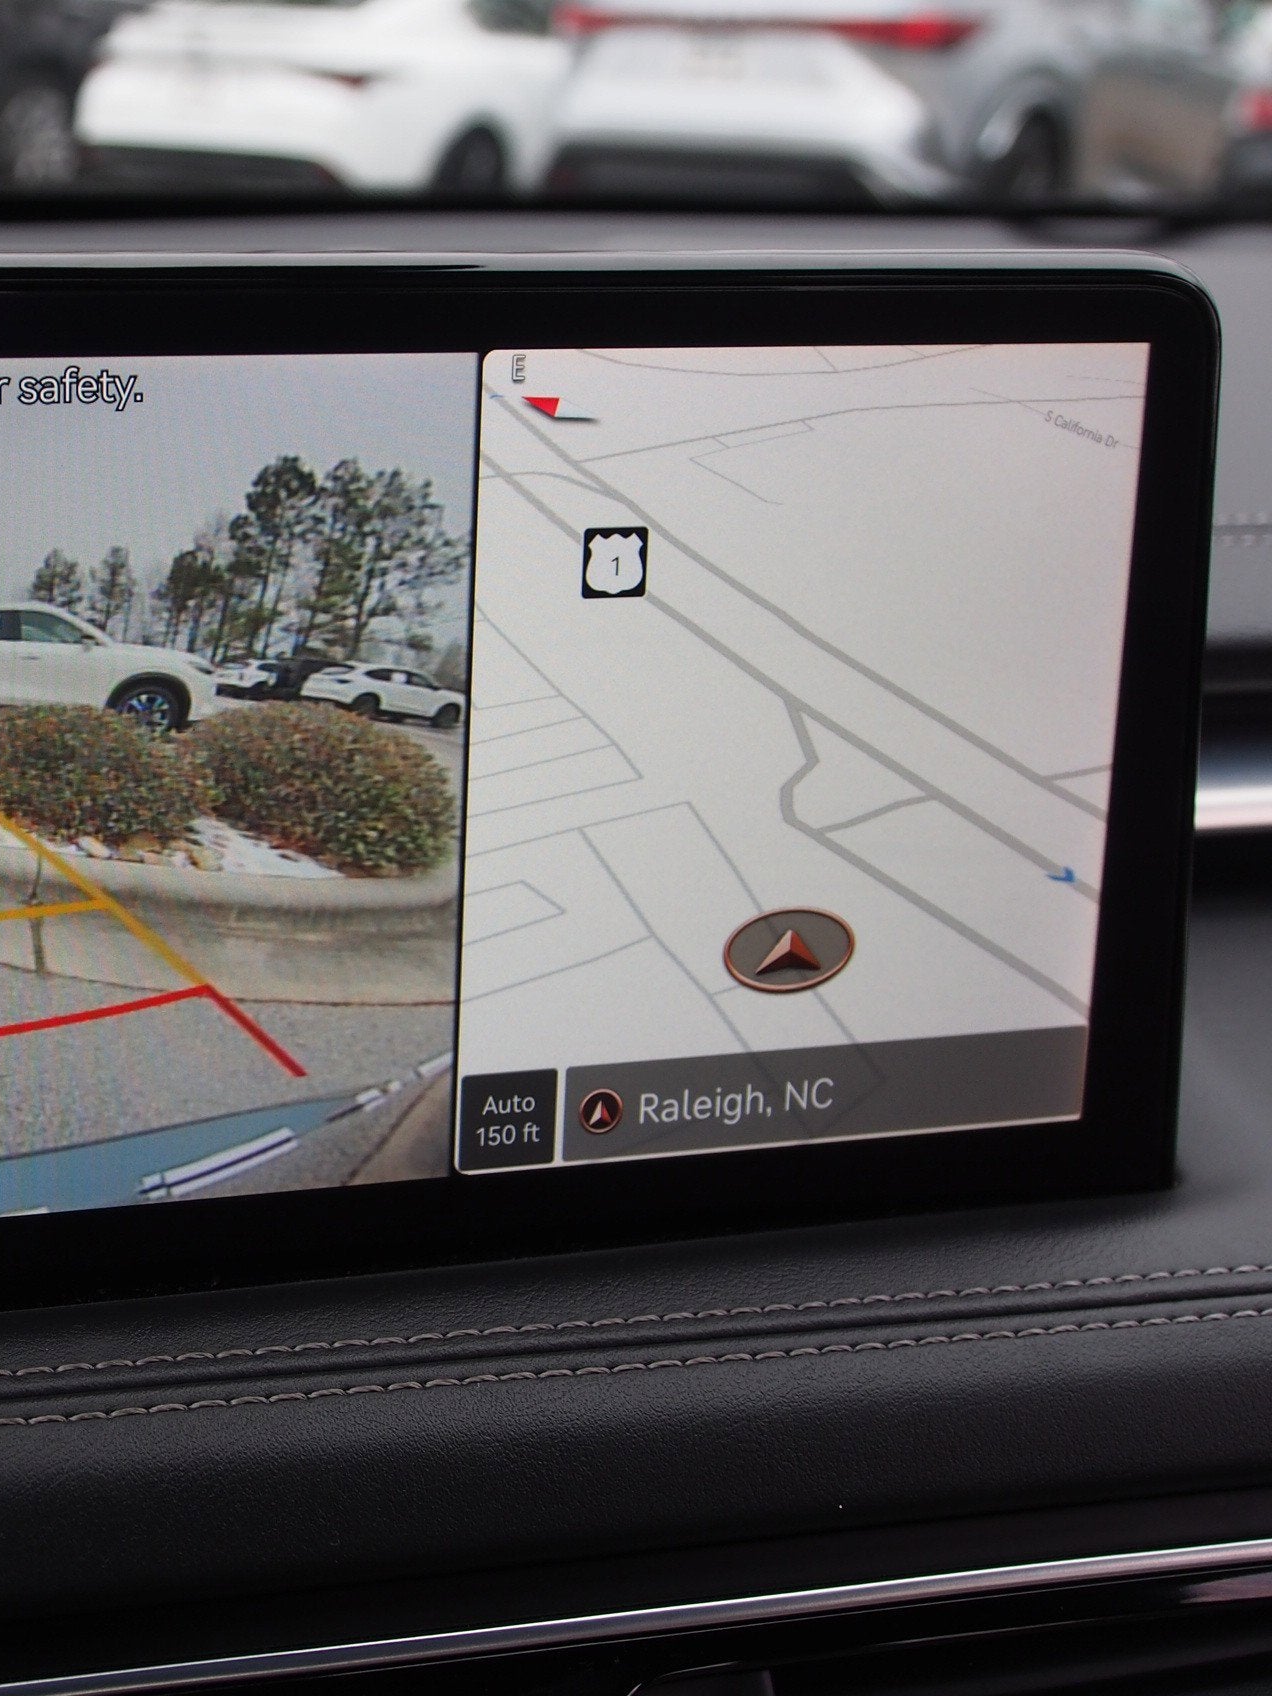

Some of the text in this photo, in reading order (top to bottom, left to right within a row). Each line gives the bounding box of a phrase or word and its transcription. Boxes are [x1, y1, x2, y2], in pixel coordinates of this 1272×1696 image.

[512, 354, 526, 383] E
[18, 366, 144, 412] safety.
[1044, 410, 1119, 448] S California Dr
[611, 556, 620, 577] 1
[482, 1094, 536, 1116] Auto
[639, 1077, 834, 1125] Raleigh, NC
[476, 1122, 540, 1147] 150 ft
